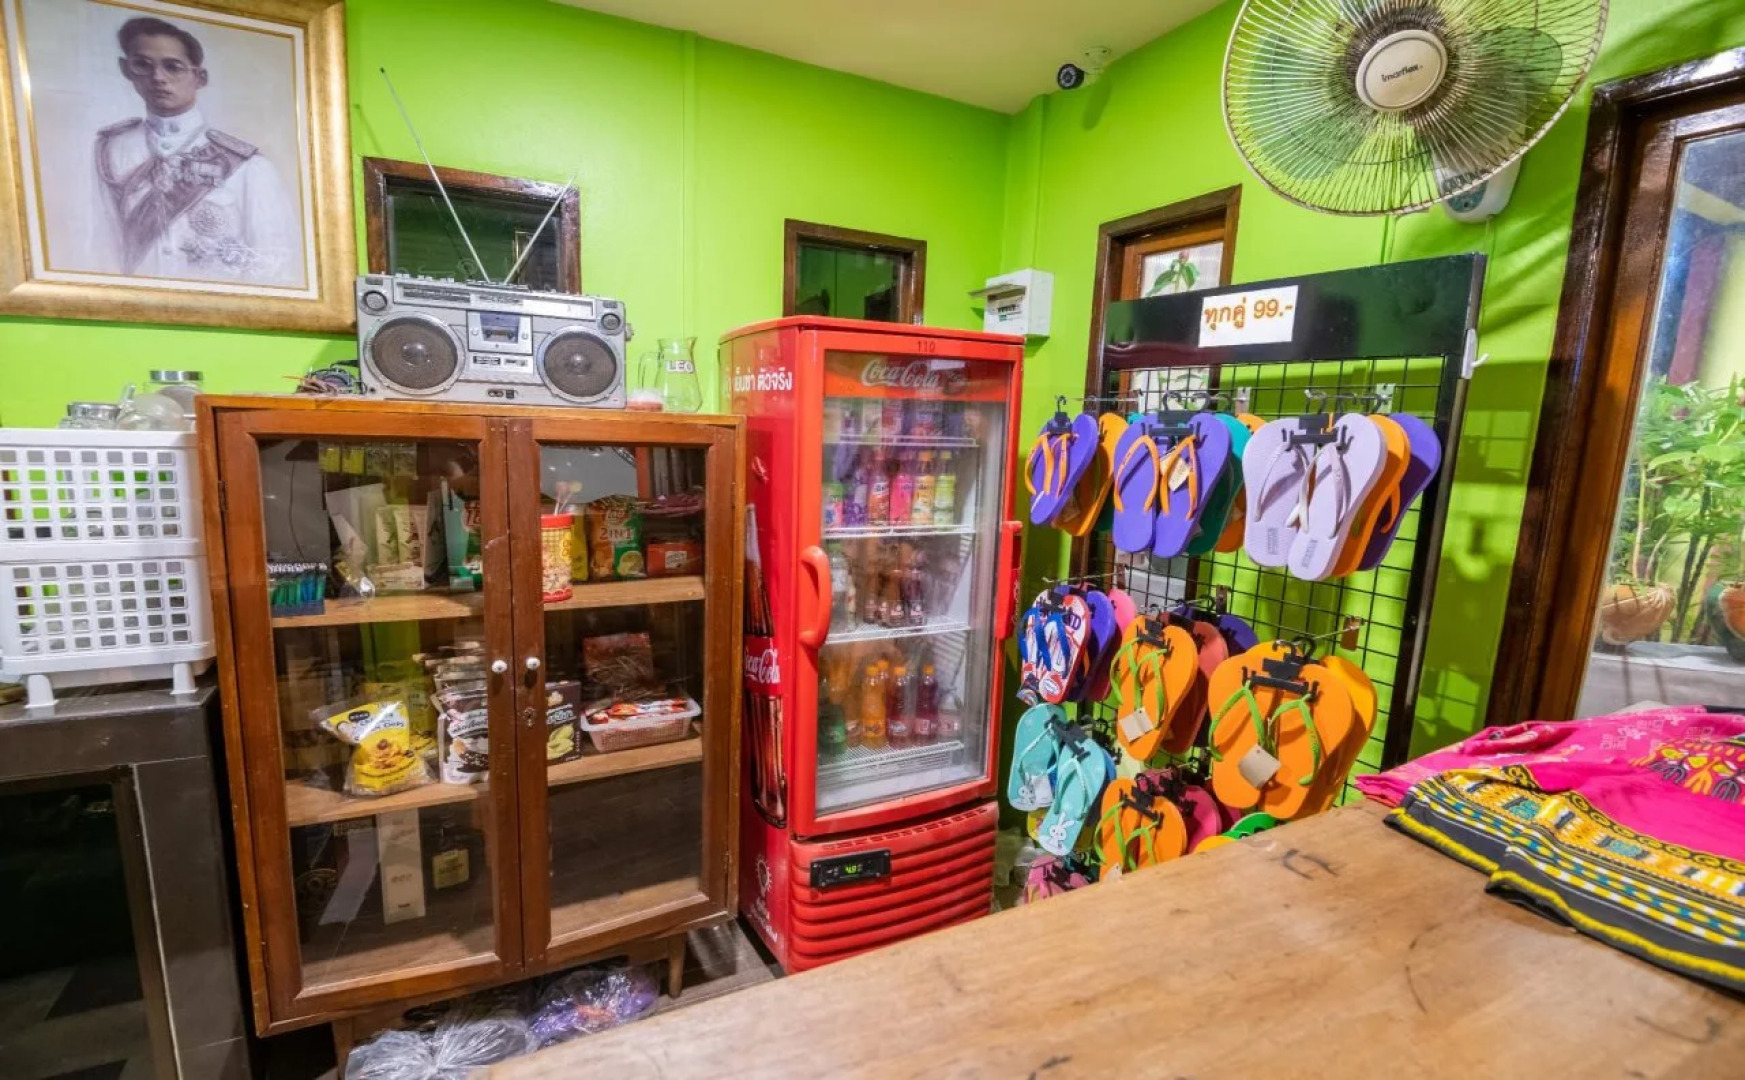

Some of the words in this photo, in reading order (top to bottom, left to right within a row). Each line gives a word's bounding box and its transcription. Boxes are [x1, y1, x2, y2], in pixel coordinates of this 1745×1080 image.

[1203, 296, 1247, 331] ทุกคู่
[1253, 298, 1293, 320] 99.-
[666, 359, 694, 373] LEO
